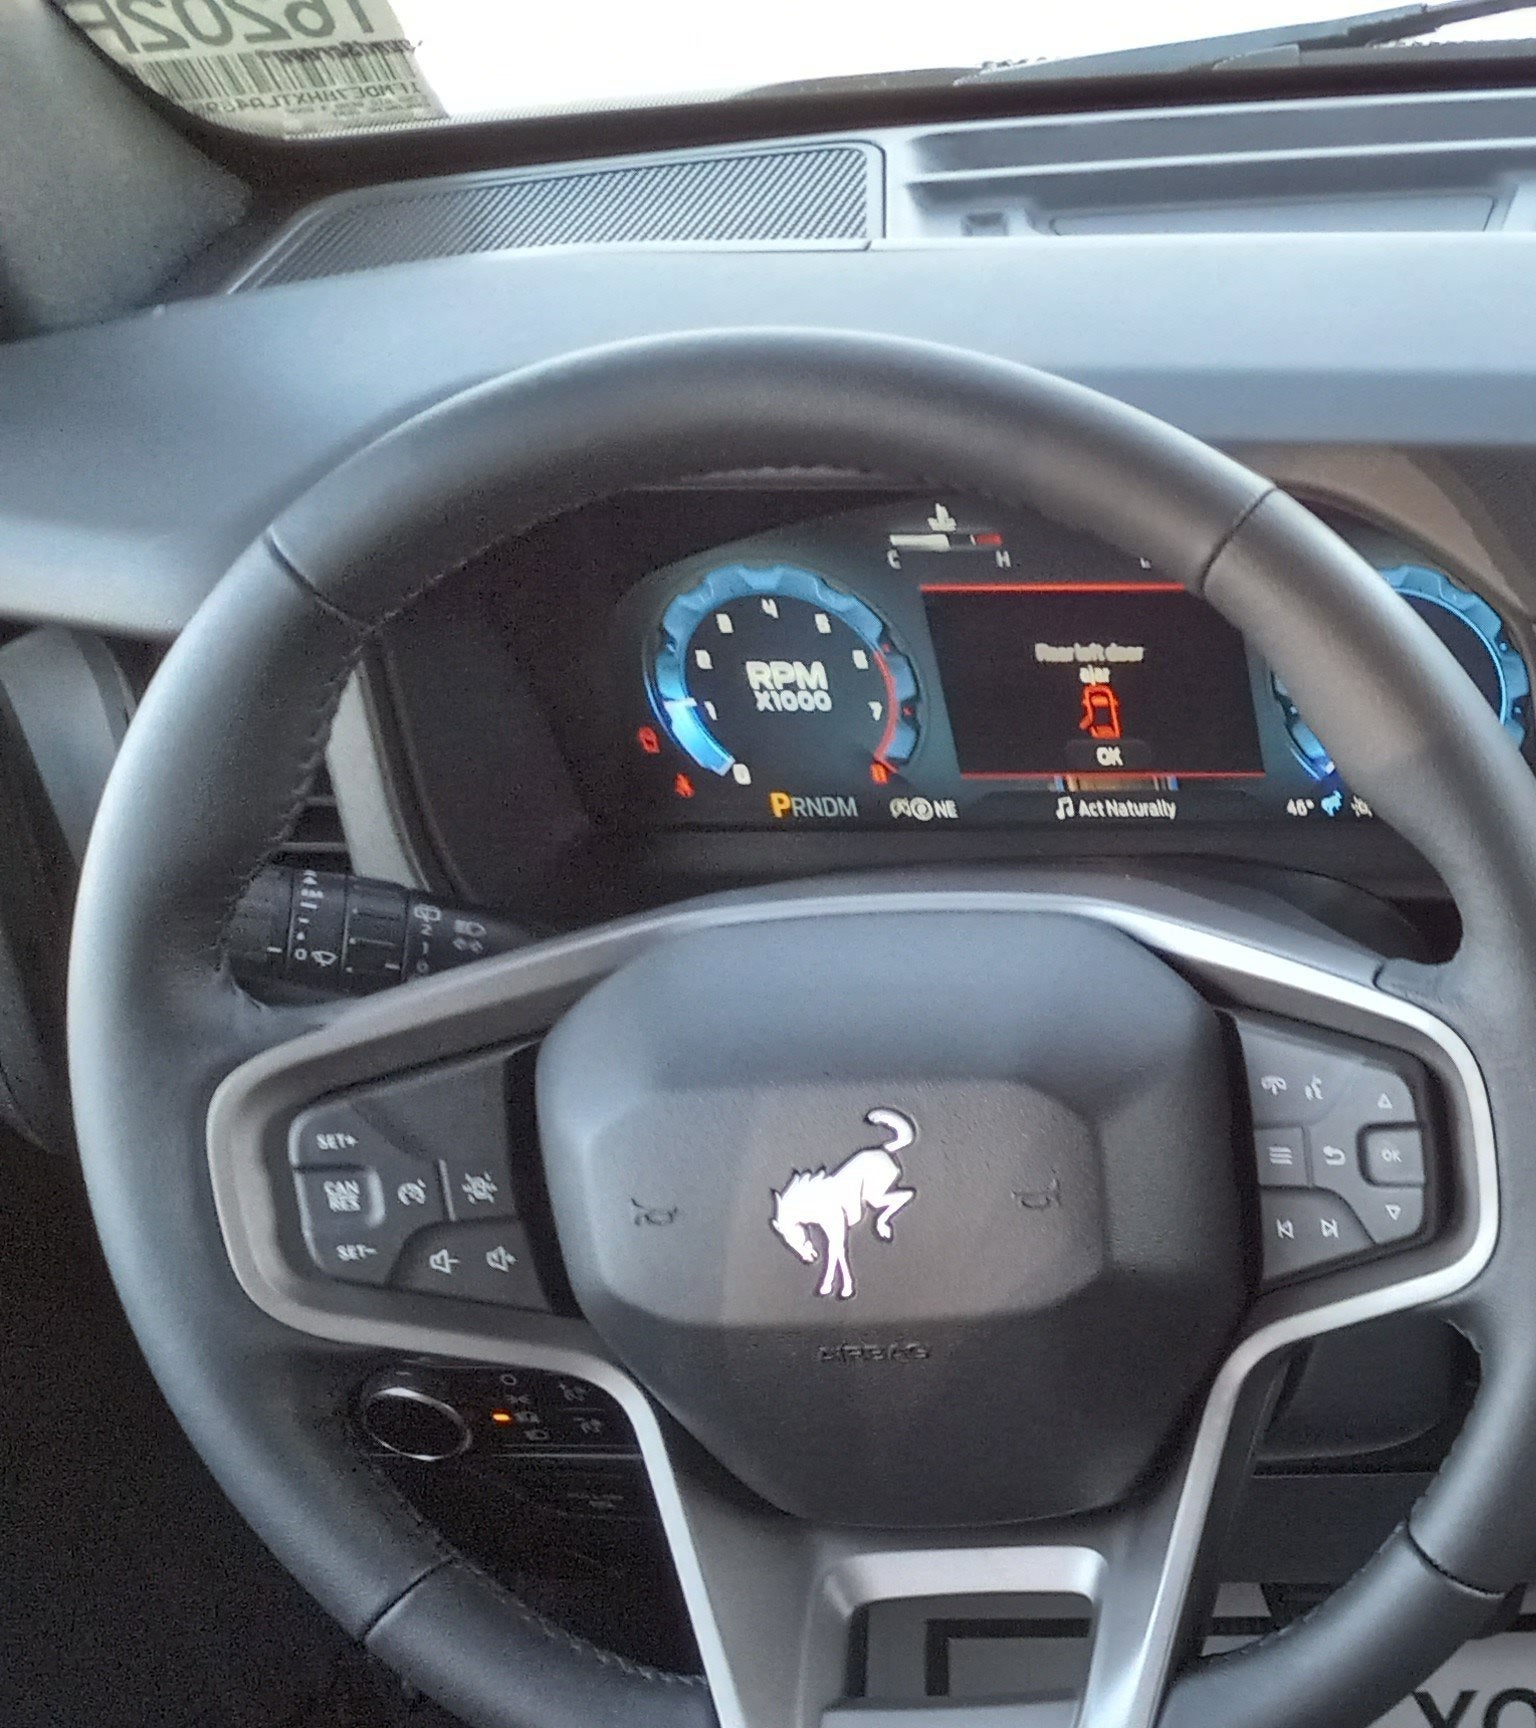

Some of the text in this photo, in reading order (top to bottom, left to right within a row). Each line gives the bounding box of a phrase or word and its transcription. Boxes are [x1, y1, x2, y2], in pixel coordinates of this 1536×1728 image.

[745, 661, 828, 690] RPM
[1096, 747, 1123, 766] OK
[769, 791, 859, 818] PRNDM
[933, 800, 959, 820] NE
[1078, 798, 1177, 821] Act Naturally
[1381, 1148, 1402, 1163] OK
